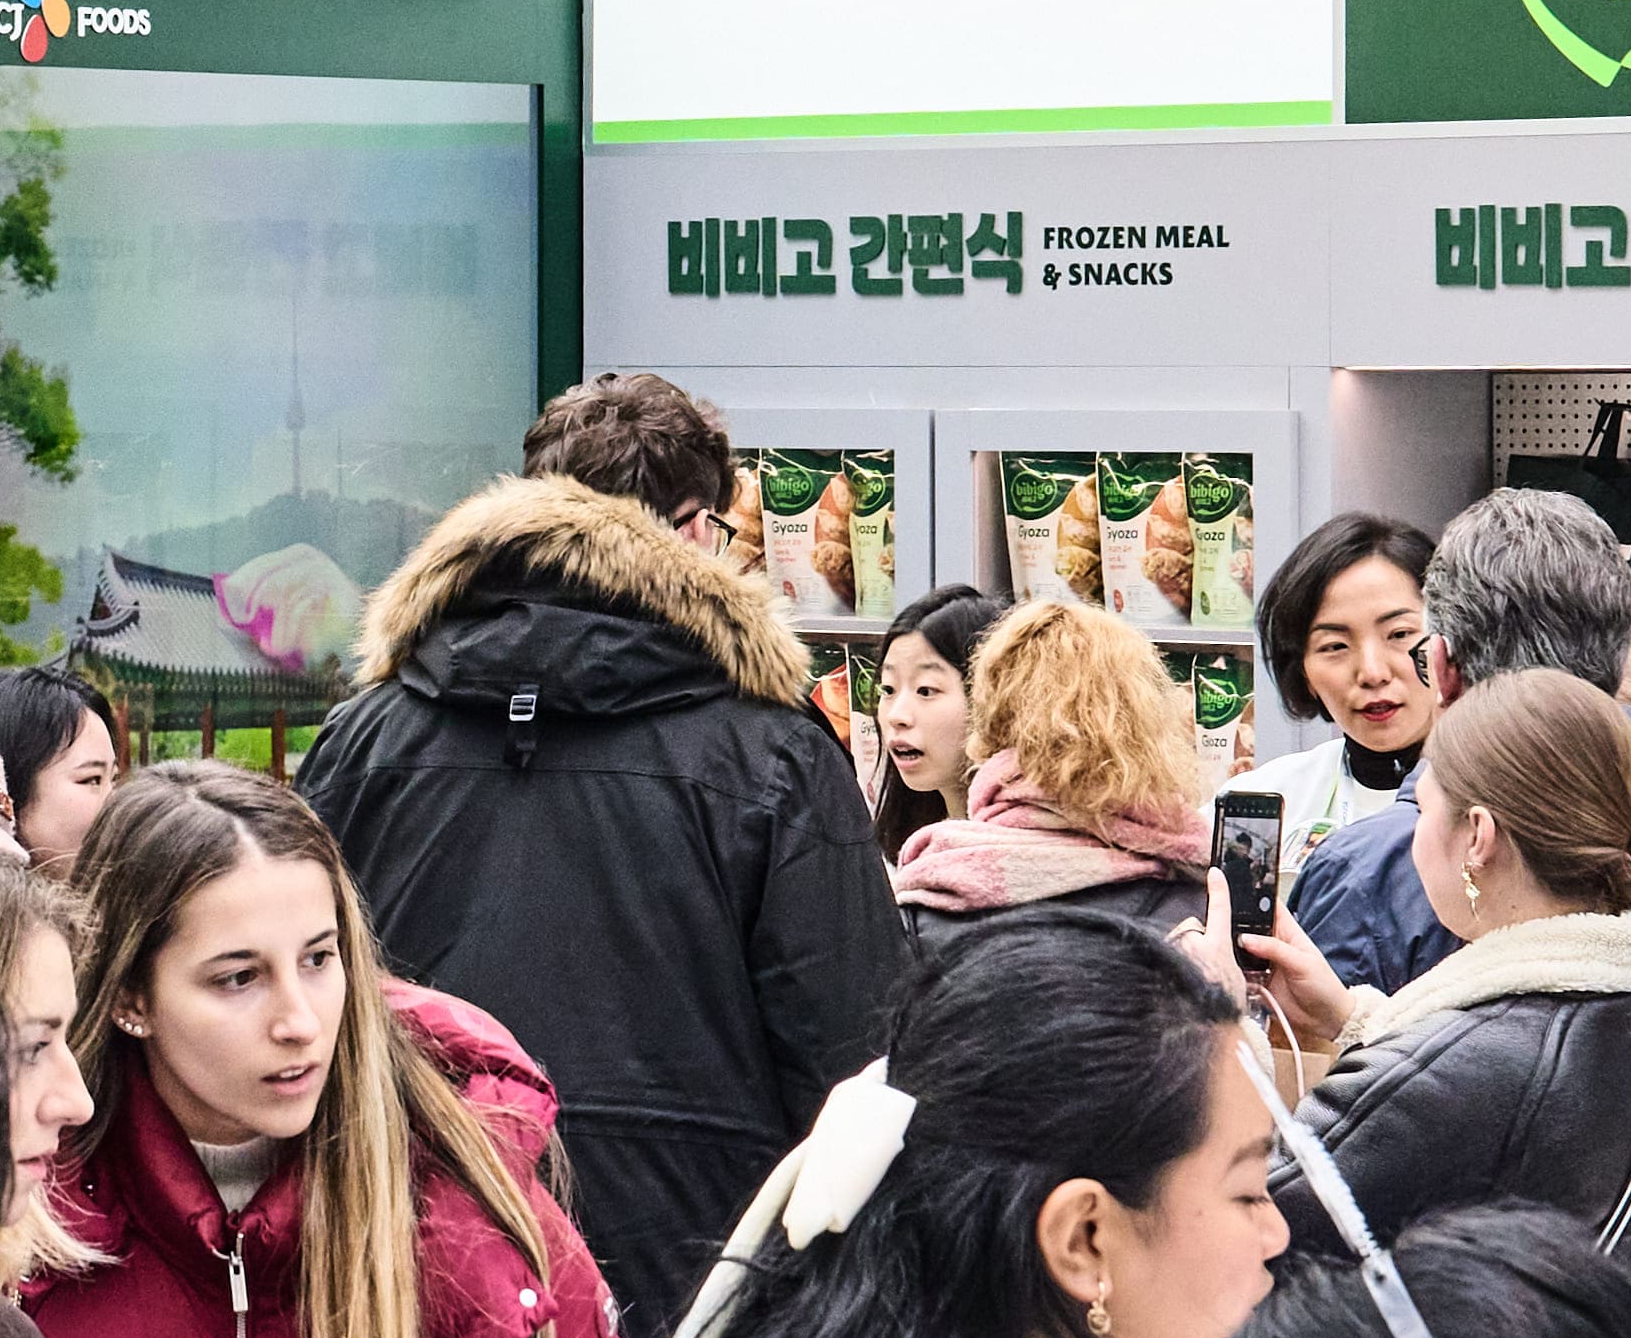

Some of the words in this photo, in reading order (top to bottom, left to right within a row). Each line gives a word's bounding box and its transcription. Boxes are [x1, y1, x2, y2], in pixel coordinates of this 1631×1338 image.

[77, 6, 151, 39] FOODS
[1042, 224, 1147, 250] FROZEN
[1154, 224, 1230, 248] MEAL
[667, 215, 834, 297] 비비고
[848, 209, 1025, 295] 간편식
[1041, 263, 1061, 289] &
[1066, 261, 1173, 287] SNACKS
